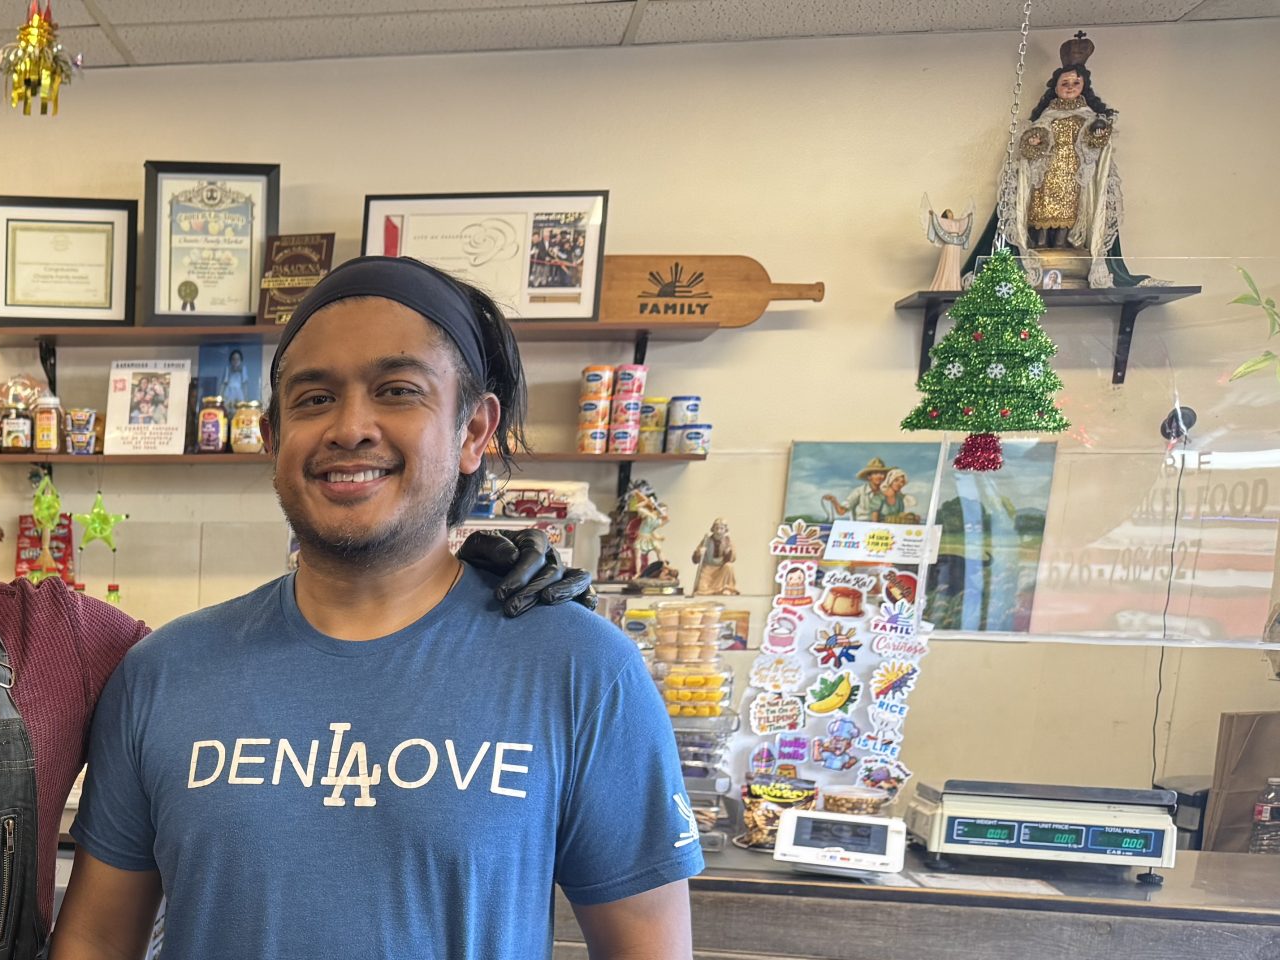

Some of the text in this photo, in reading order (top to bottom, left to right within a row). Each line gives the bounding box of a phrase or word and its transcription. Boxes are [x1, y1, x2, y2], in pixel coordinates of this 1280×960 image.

[639, 303, 710, 315] FAMILY
[1194, 478, 1269, 519] FOOD
[772, 545, 820, 555] FAMILY
[825, 574, 873, 588] Leche Ka!
[877, 700, 907, 715] RICE
[757, 714, 798, 725] FILIPINO
[872, 741, 897, 756] LIFE
